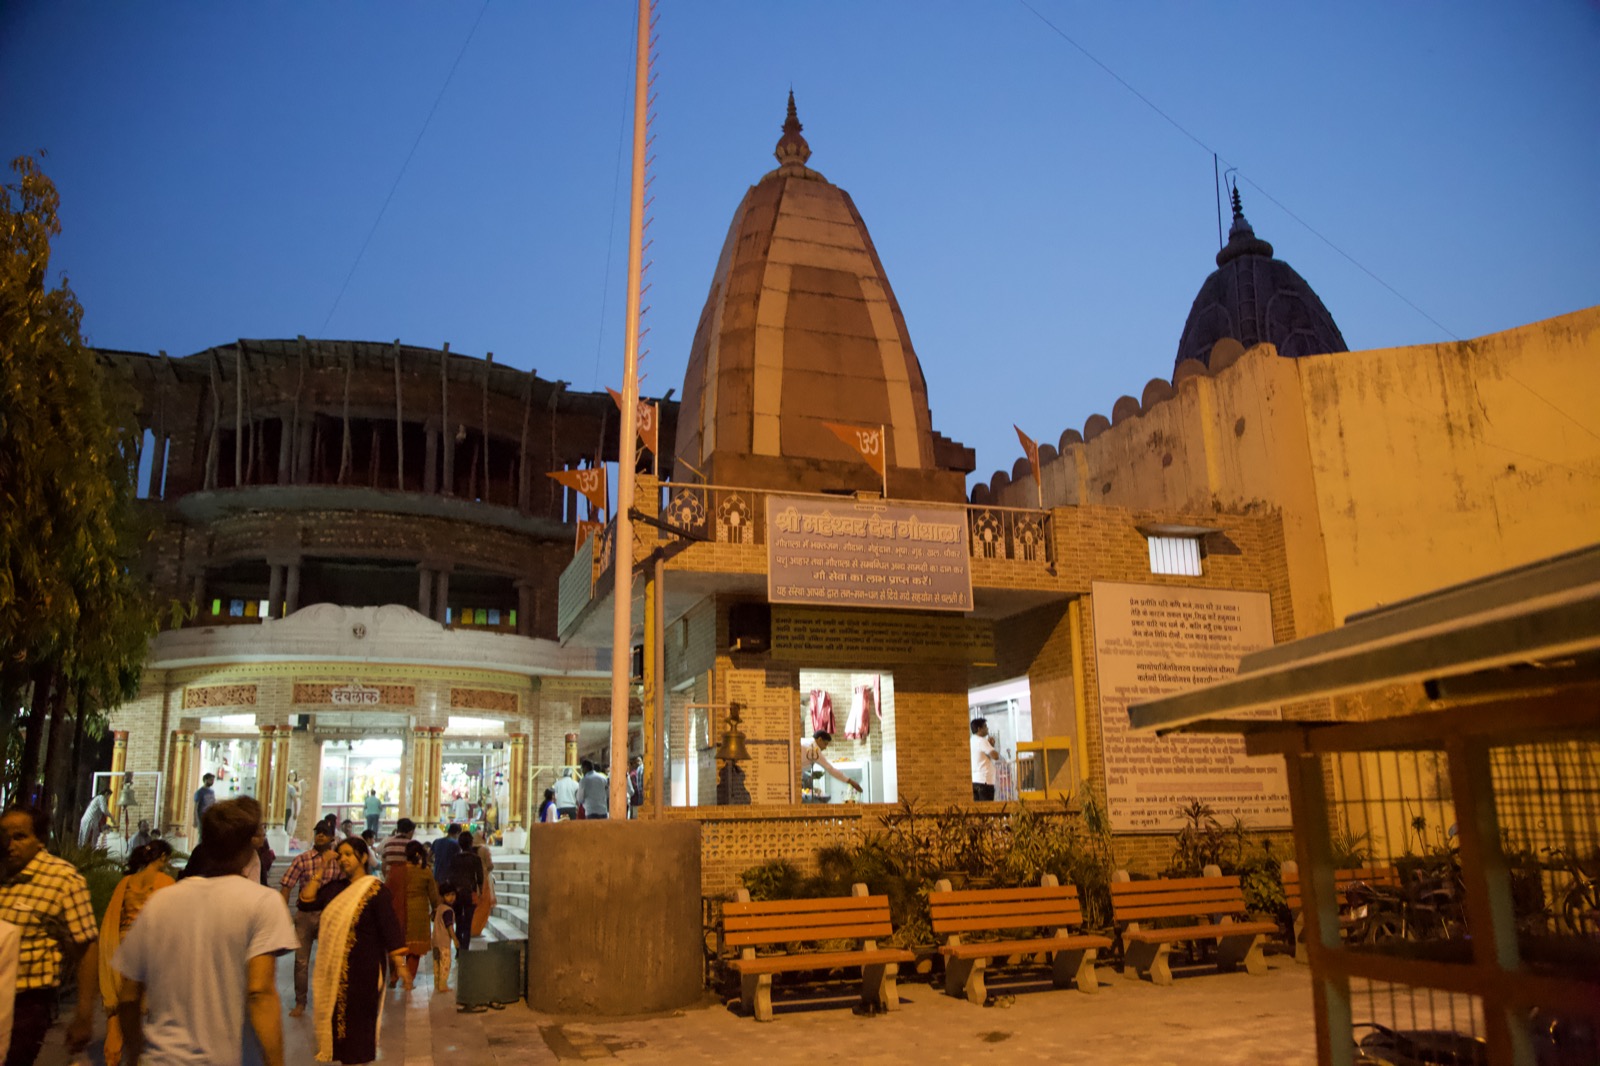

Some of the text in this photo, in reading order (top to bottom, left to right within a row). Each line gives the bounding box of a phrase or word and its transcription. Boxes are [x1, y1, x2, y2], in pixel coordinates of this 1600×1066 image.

[775, 506, 802, 533] श्री
[803, 510, 868, 539] महेश्वर
[869, 513, 896, 539] देव
[829, 570, 847, 581] सेवा
[850, 574, 863, 582] का
[866, 575, 886, 584] लाभ
[889, 576, 910, 585] प्राप्त
